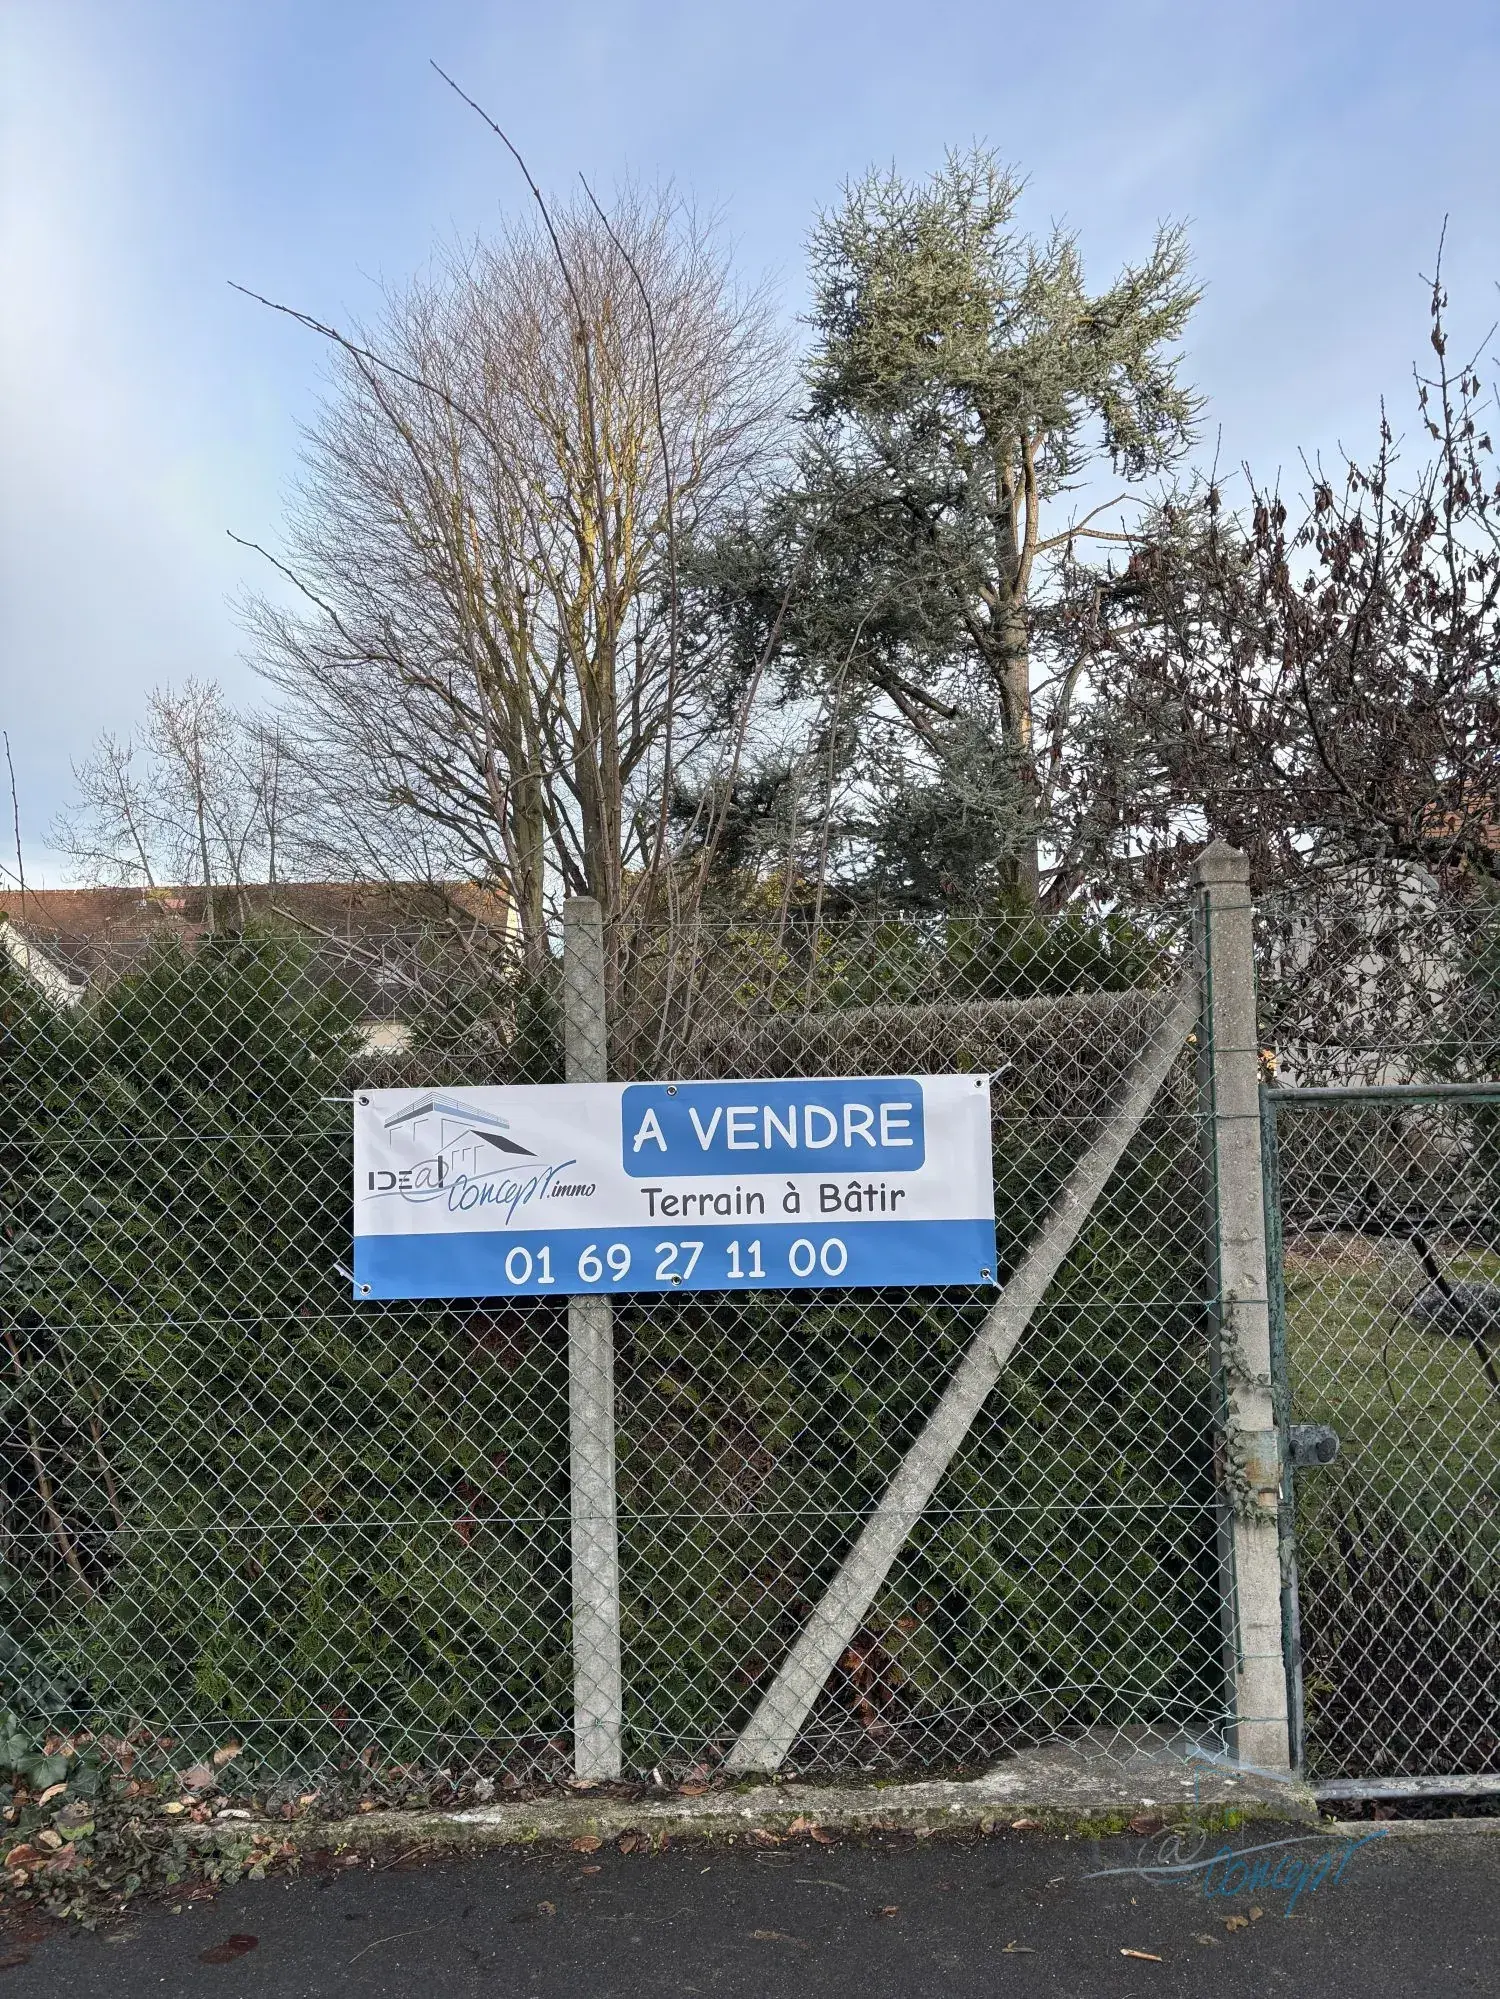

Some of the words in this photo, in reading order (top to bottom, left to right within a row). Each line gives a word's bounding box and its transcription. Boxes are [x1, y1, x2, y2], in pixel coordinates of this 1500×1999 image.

[633, 1107, 668, 1153] A
[688, 1102, 914, 1151] VENDRE
[640, 1185, 765, 1217] Terrain
[781, 1180, 801, 1214] à
[818, 1180, 905, 1214] Bâtir
[504, 1245, 555, 1285] 01
[577, 1243, 632, 1283] 69
[654, 1241, 705, 1281] 27
[726, 1239, 766, 1279] 11
[787, 1237, 848, 1277] 00
